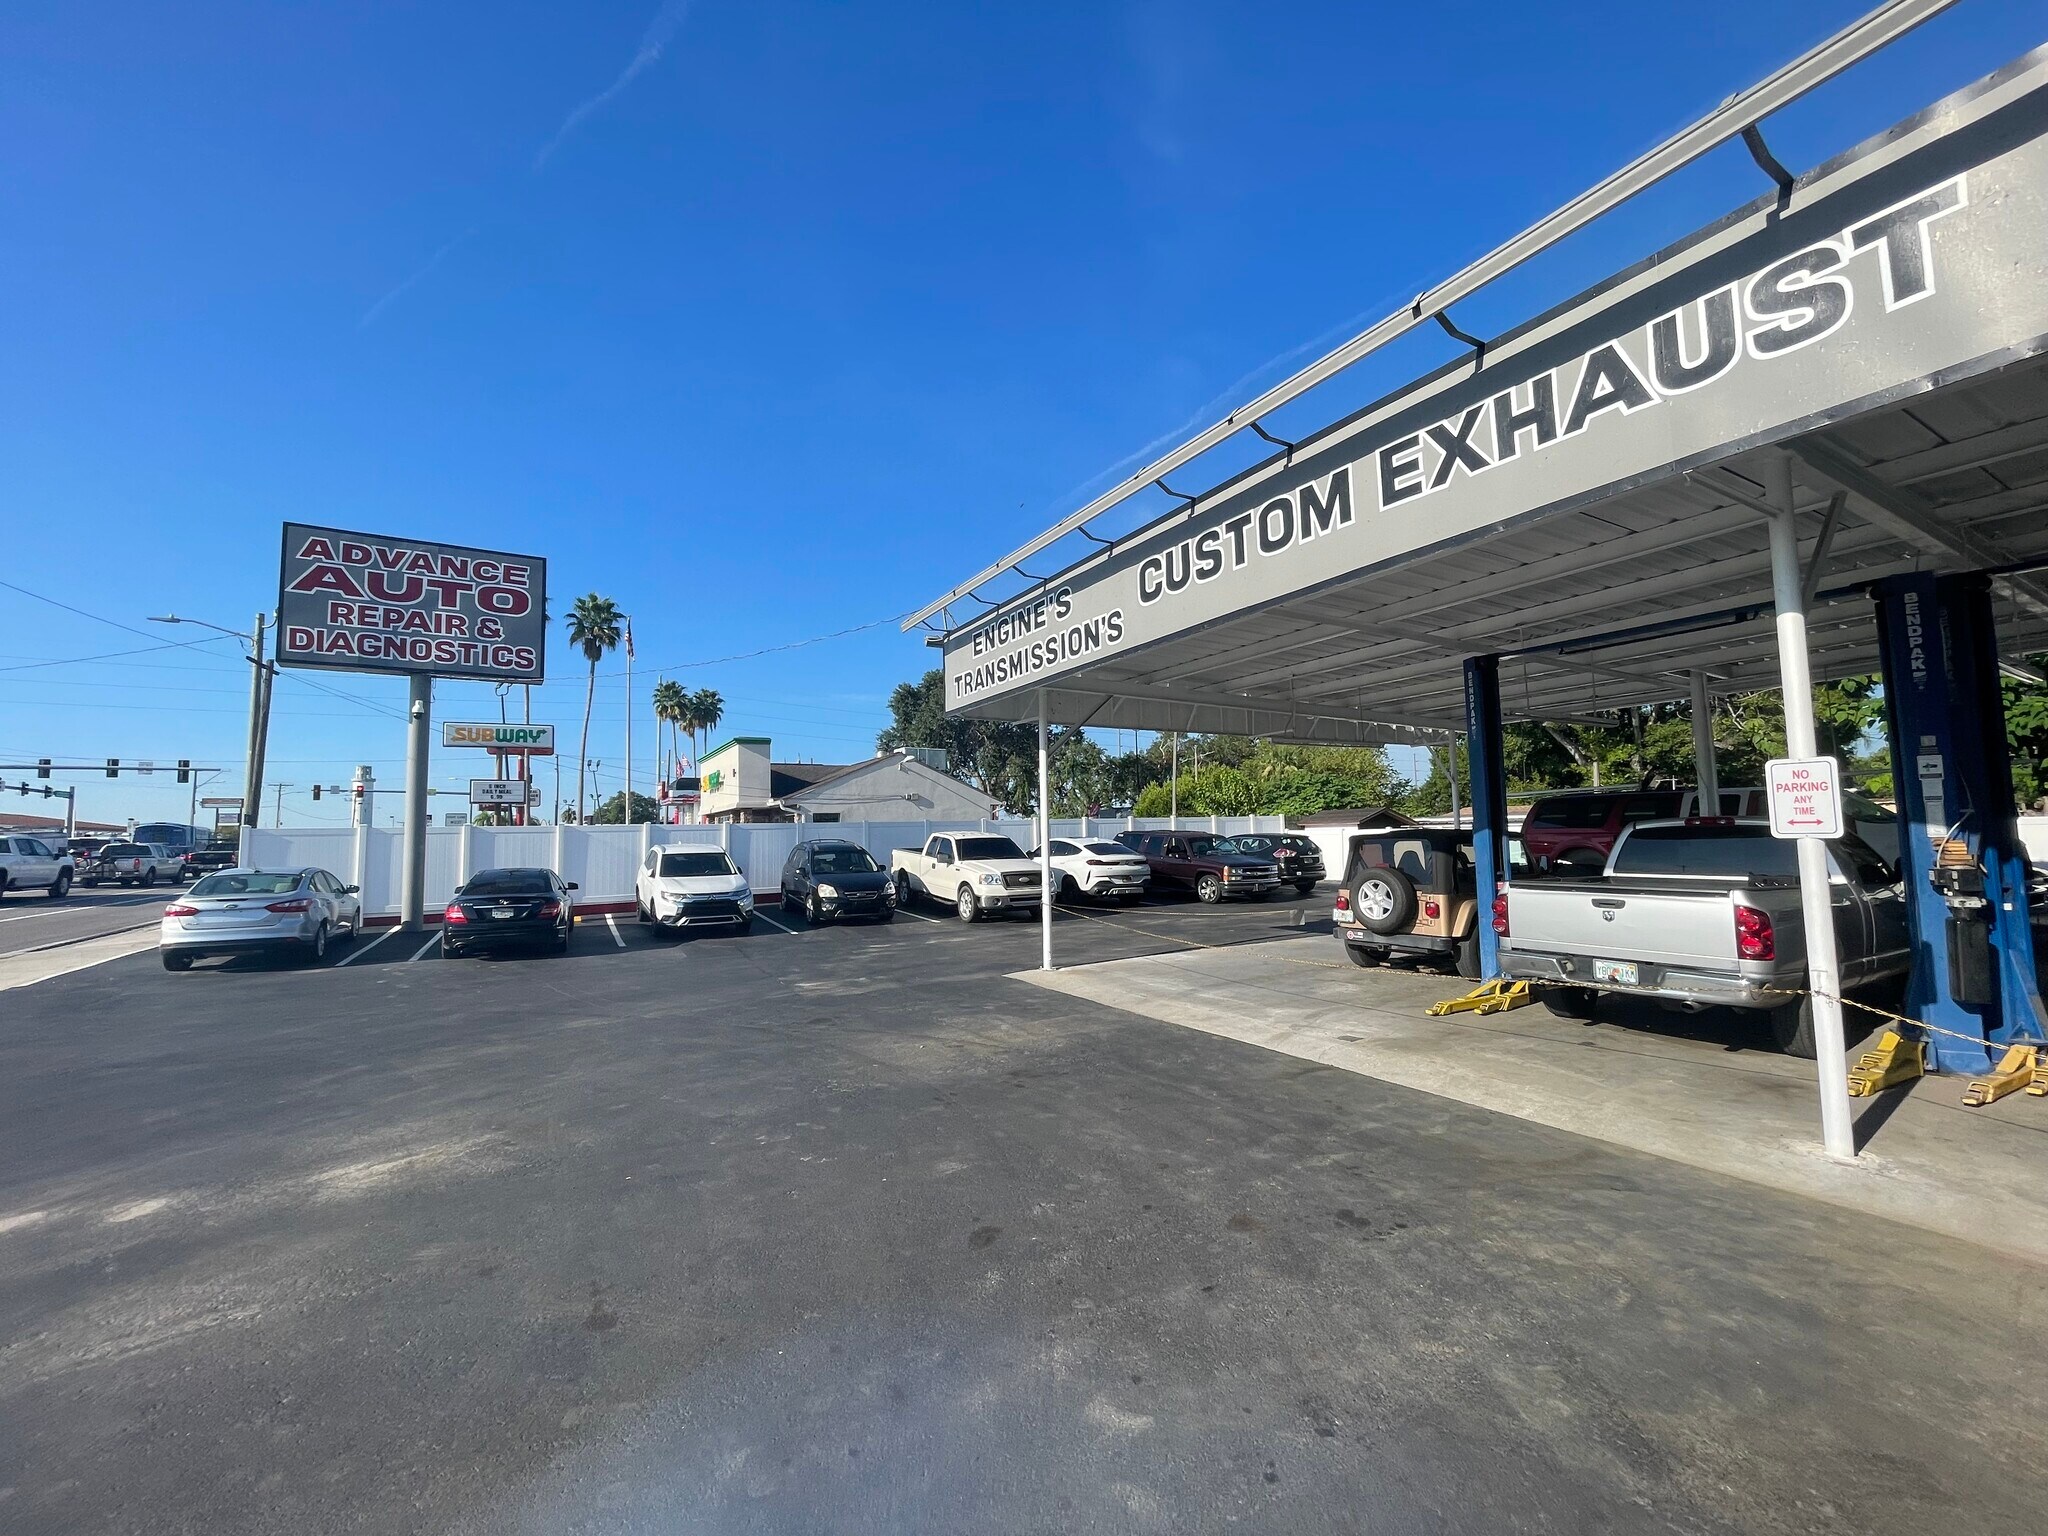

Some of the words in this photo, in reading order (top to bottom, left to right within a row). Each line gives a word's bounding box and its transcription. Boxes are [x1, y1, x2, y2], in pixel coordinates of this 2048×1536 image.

[1137, 466, 1356, 607] CUSTOM
[1375, 173, 1968, 512] EXHAUST
[296, 536, 530, 587] ADVANCE
[285, 562, 531, 617] AUTO
[327, 600, 470, 639] REPAIR
[474, 616, 506, 642] &
[972, 586, 1073, 659] ENGINE'S
[1904, 592, 1926, 670] BENDPAK
[286, 625, 536, 672] DIAGNOSTICS
[953, 608, 1125, 699] TRANSMISSION'S
[1467, 672, 1476, 725] BENDPAK
[451, 726, 547, 744] SUBWAY
[1776, 782, 1829, 793] PARKING
[1792, 770, 1809, 780] NO
[1793, 795, 1813, 804] ANY
[1793, 807, 1816, 816] TIME
